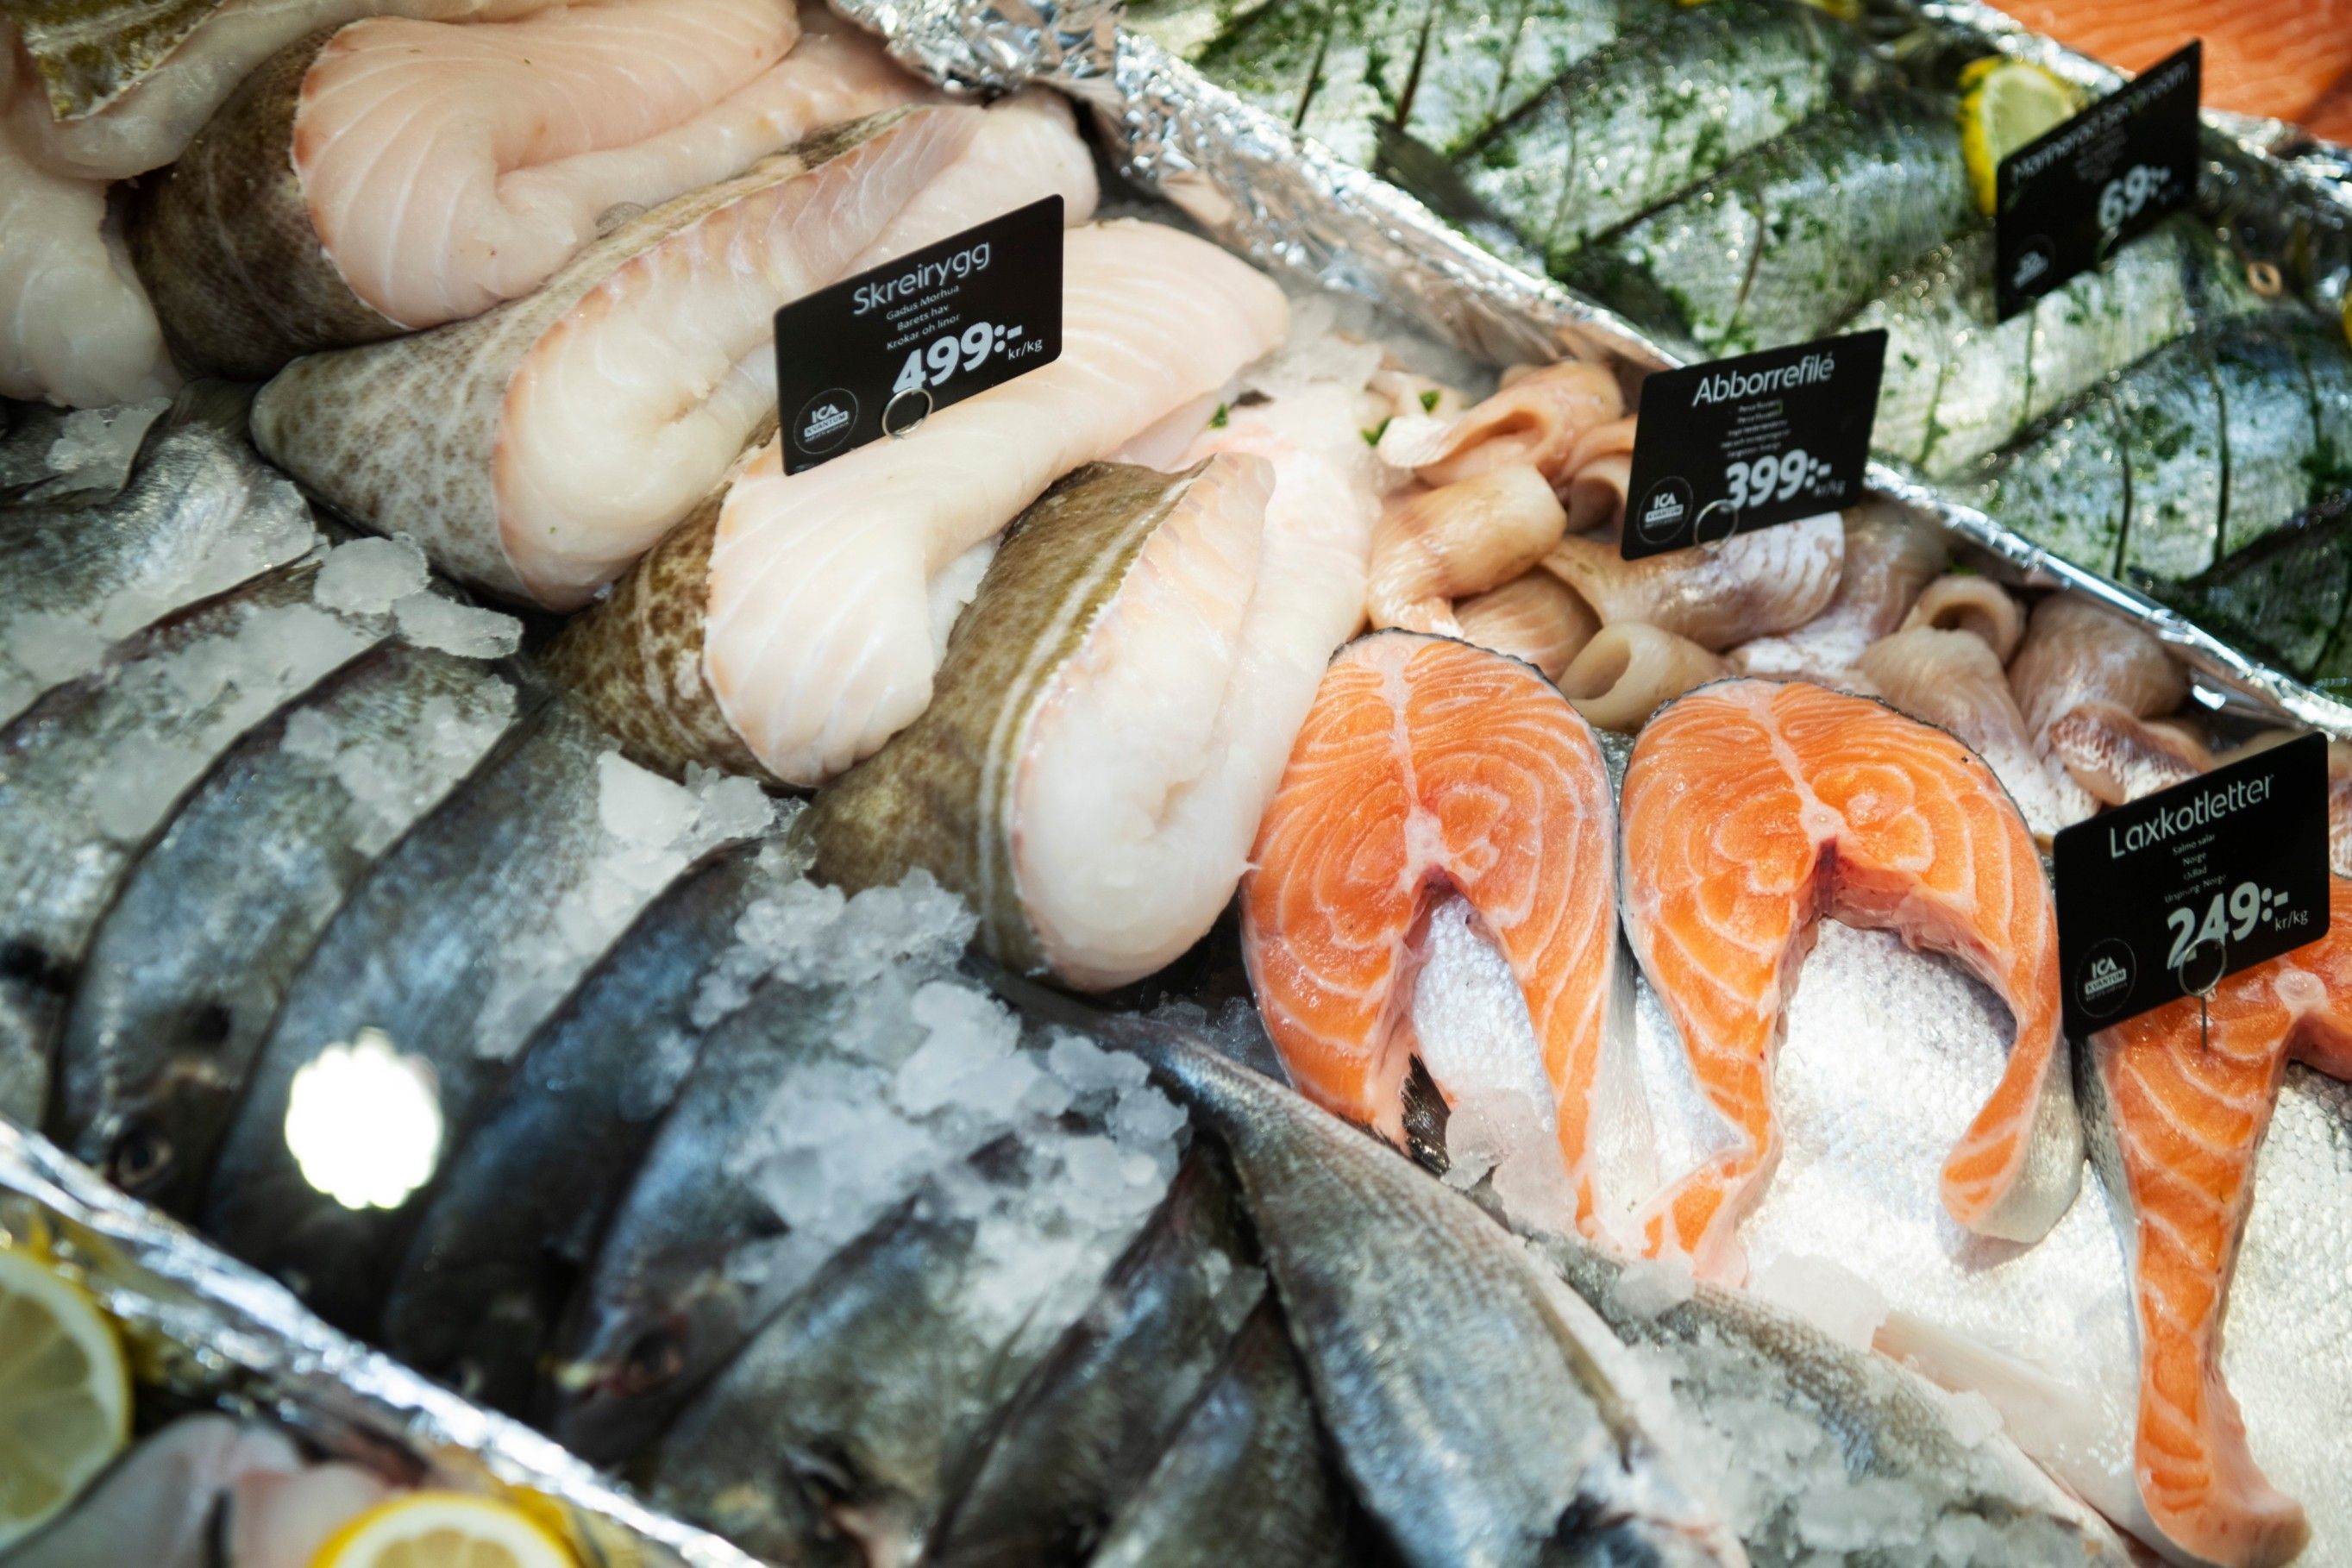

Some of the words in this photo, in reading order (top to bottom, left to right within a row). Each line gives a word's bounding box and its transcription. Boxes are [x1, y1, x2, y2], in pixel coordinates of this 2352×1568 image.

[853, 241, 990, 315] Skreirygg
[886, 301, 918, 320] Gadus
[919, 284, 960, 307] Morhua
[897, 311, 930, 331] Barets
[931, 303, 949, 319] hav
[887, 331, 920, 350] Krokar
[922, 323, 936, 336] oh
[938, 313, 960, 330] linor
[893, 322, 1023, 393] 499:-
[1007, 338, 1043, 361] kr/kg
[1692, 351, 1835, 407] Abborrefilé
[806, 412, 847, 436] KVANTUM
[812, 404, 839, 423] ICA
[1720, 448, 1833, 512] 399:-
[1654, 492, 1677, 509] ICA
[2110, 775, 2274, 859] Laxkotletter
[2173, 842, 2197, 856] Salmo
[2183, 852, 2207, 867] Norge
[2167, 881, 2289, 970] 249:-
[2274, 910, 2309, 931] kr/kg
[2086, 969, 2125, 992] KVANTUM
[2092, 956, 2117, 979] ICA
